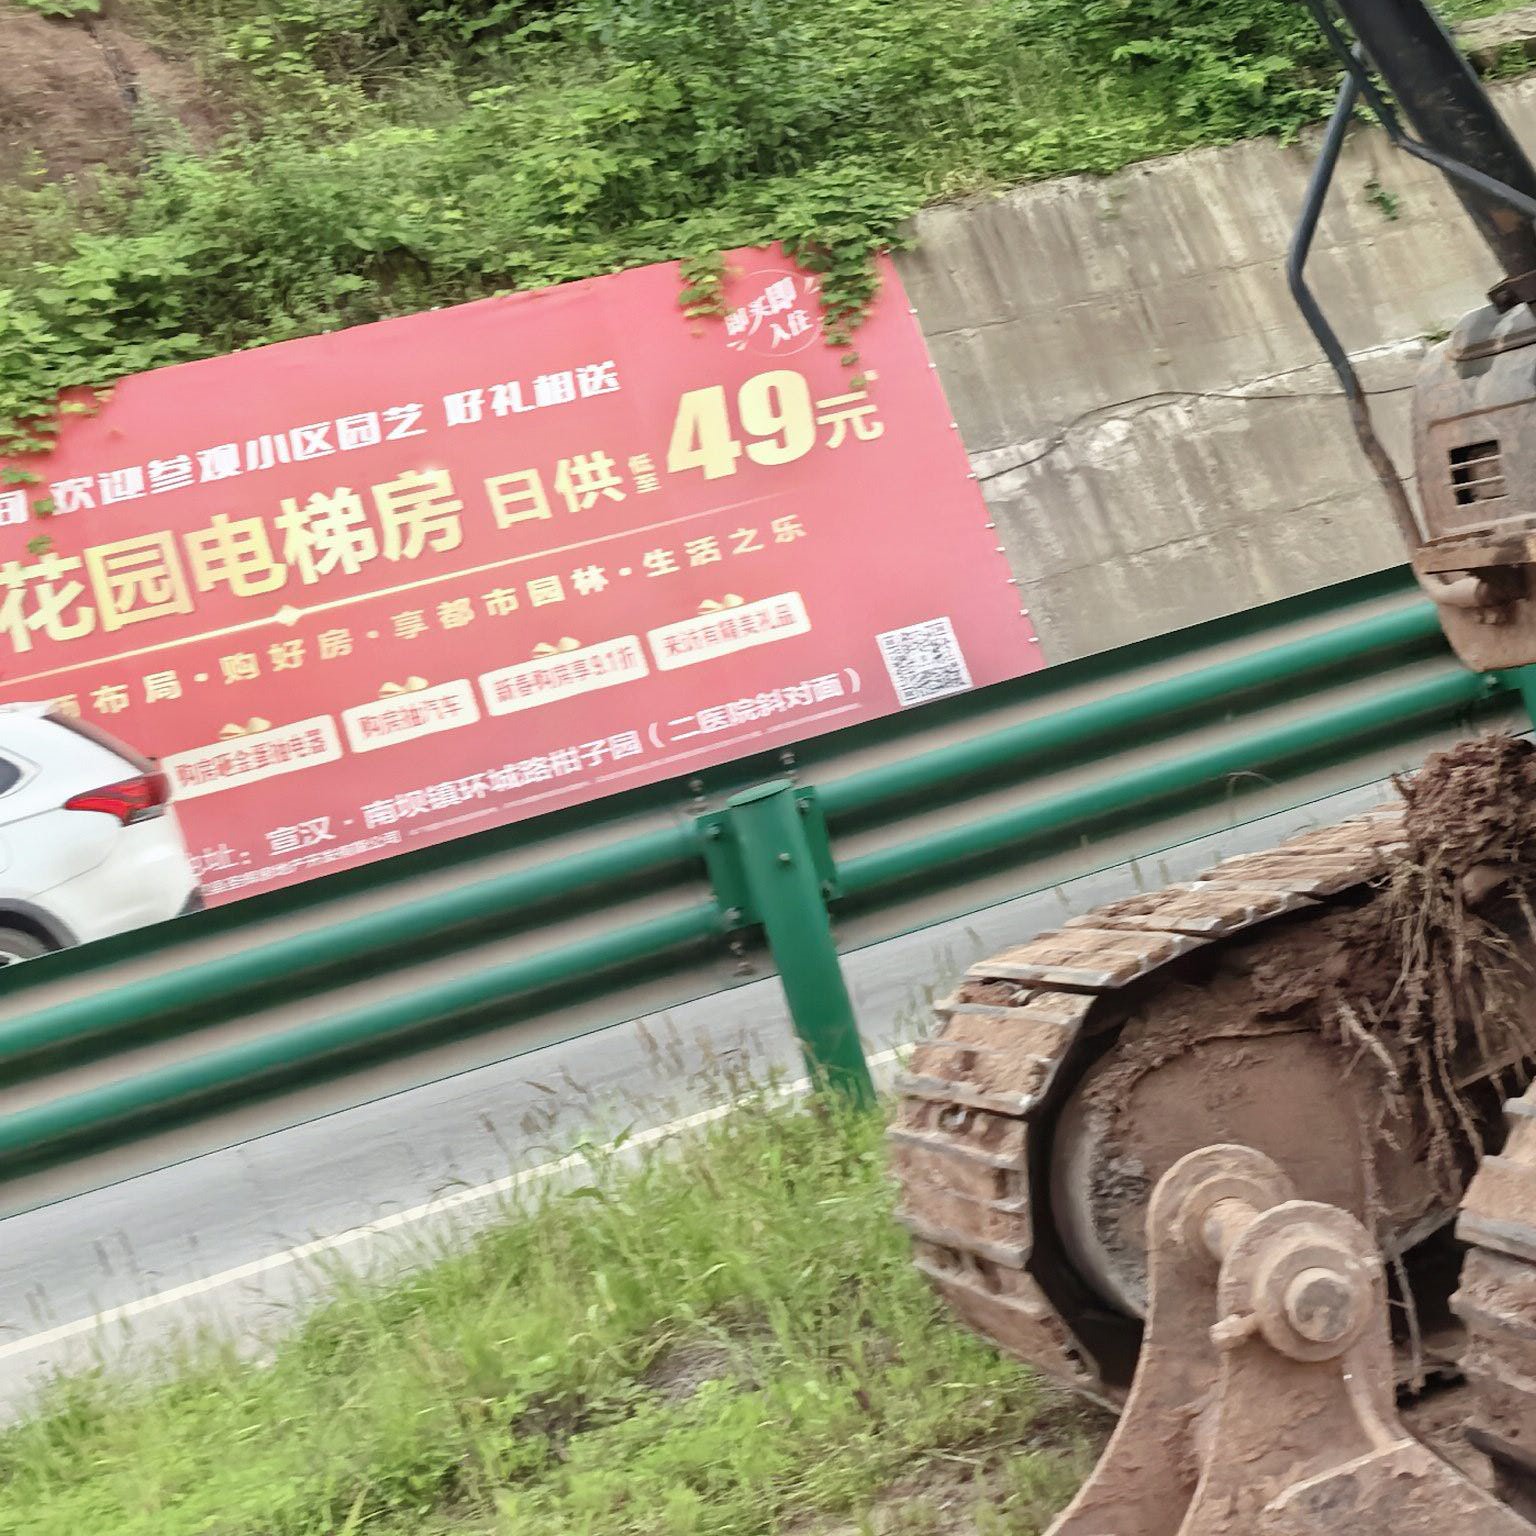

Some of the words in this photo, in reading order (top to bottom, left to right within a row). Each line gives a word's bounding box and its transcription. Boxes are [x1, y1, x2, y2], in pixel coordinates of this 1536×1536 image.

[0, 468, 464, 653] 花园电梯房
[484, 450, 627, 529] 日供
[667, 370, 884, 480] 49元
[49, 403, 427, 516] 欢迎参观小区园艺
[443, 360, 621, 426] 好礼相送
